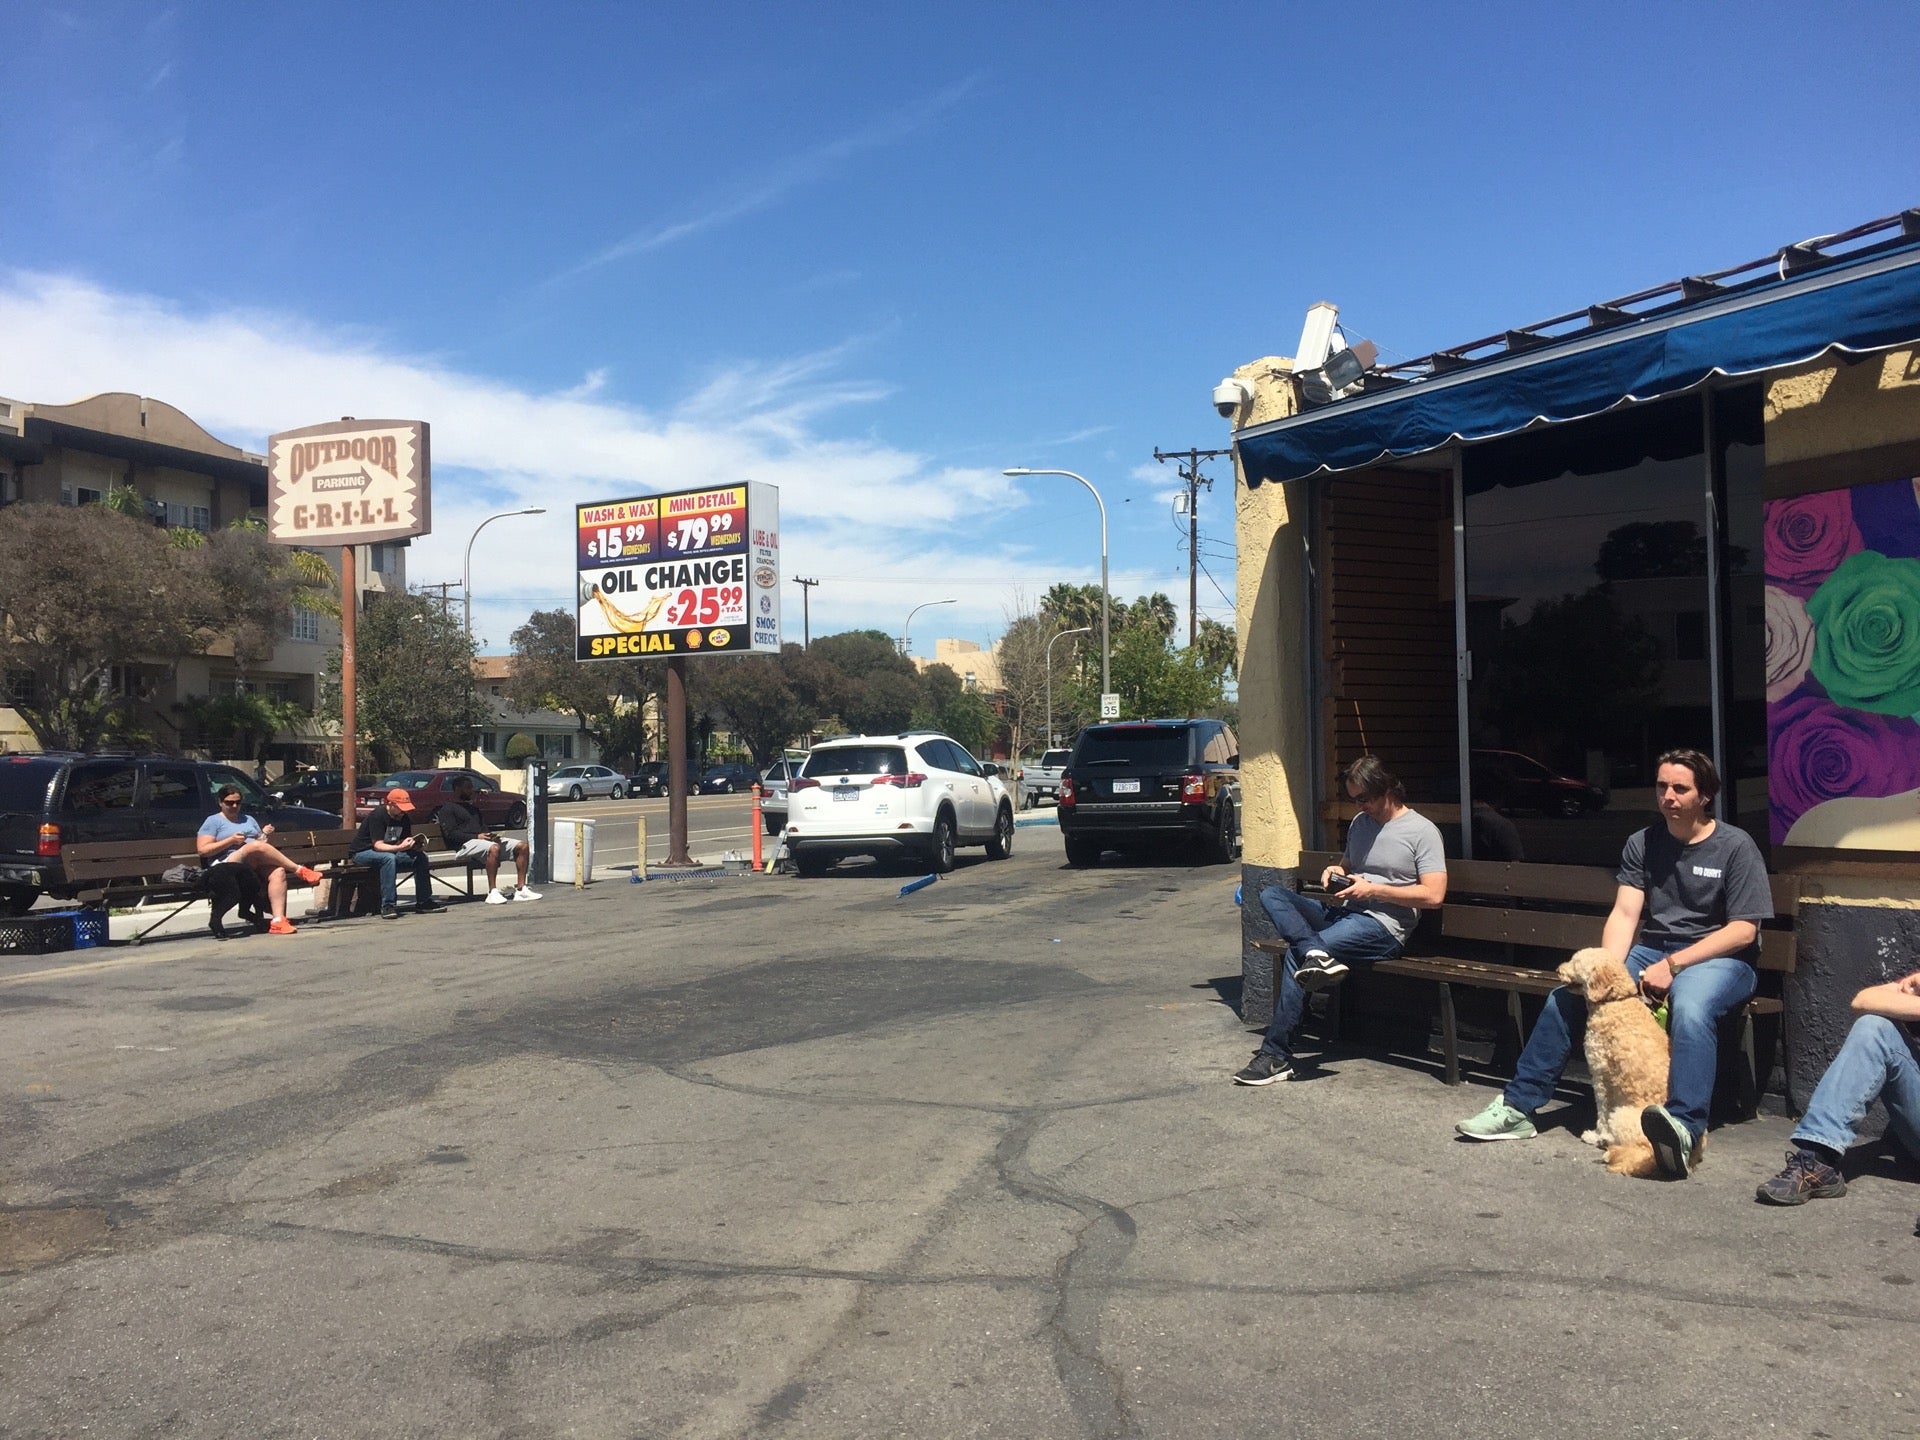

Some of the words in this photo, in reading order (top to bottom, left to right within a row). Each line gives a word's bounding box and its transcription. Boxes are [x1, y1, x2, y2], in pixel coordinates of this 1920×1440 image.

[290, 436, 398, 484] OUTDOOR
[316, 476, 365, 489] PARKING
[670, 498, 695, 512] MINI
[698, 492, 736, 508] DETAIL
[584, 508, 614, 523] WASH
[618, 507, 626, 519] &
[628, 502, 655, 518] WAX
[753, 529, 765, 546] LUBE
[601, 570, 638, 594] OIL
[645, 559, 744, 590] CHANGE
[756, 616, 776, 630] SMOG
[591, 633, 675, 656] SPECIAL
[754, 632, 778, 645] CHECK
[1104, 706, 1117, 715] 35
